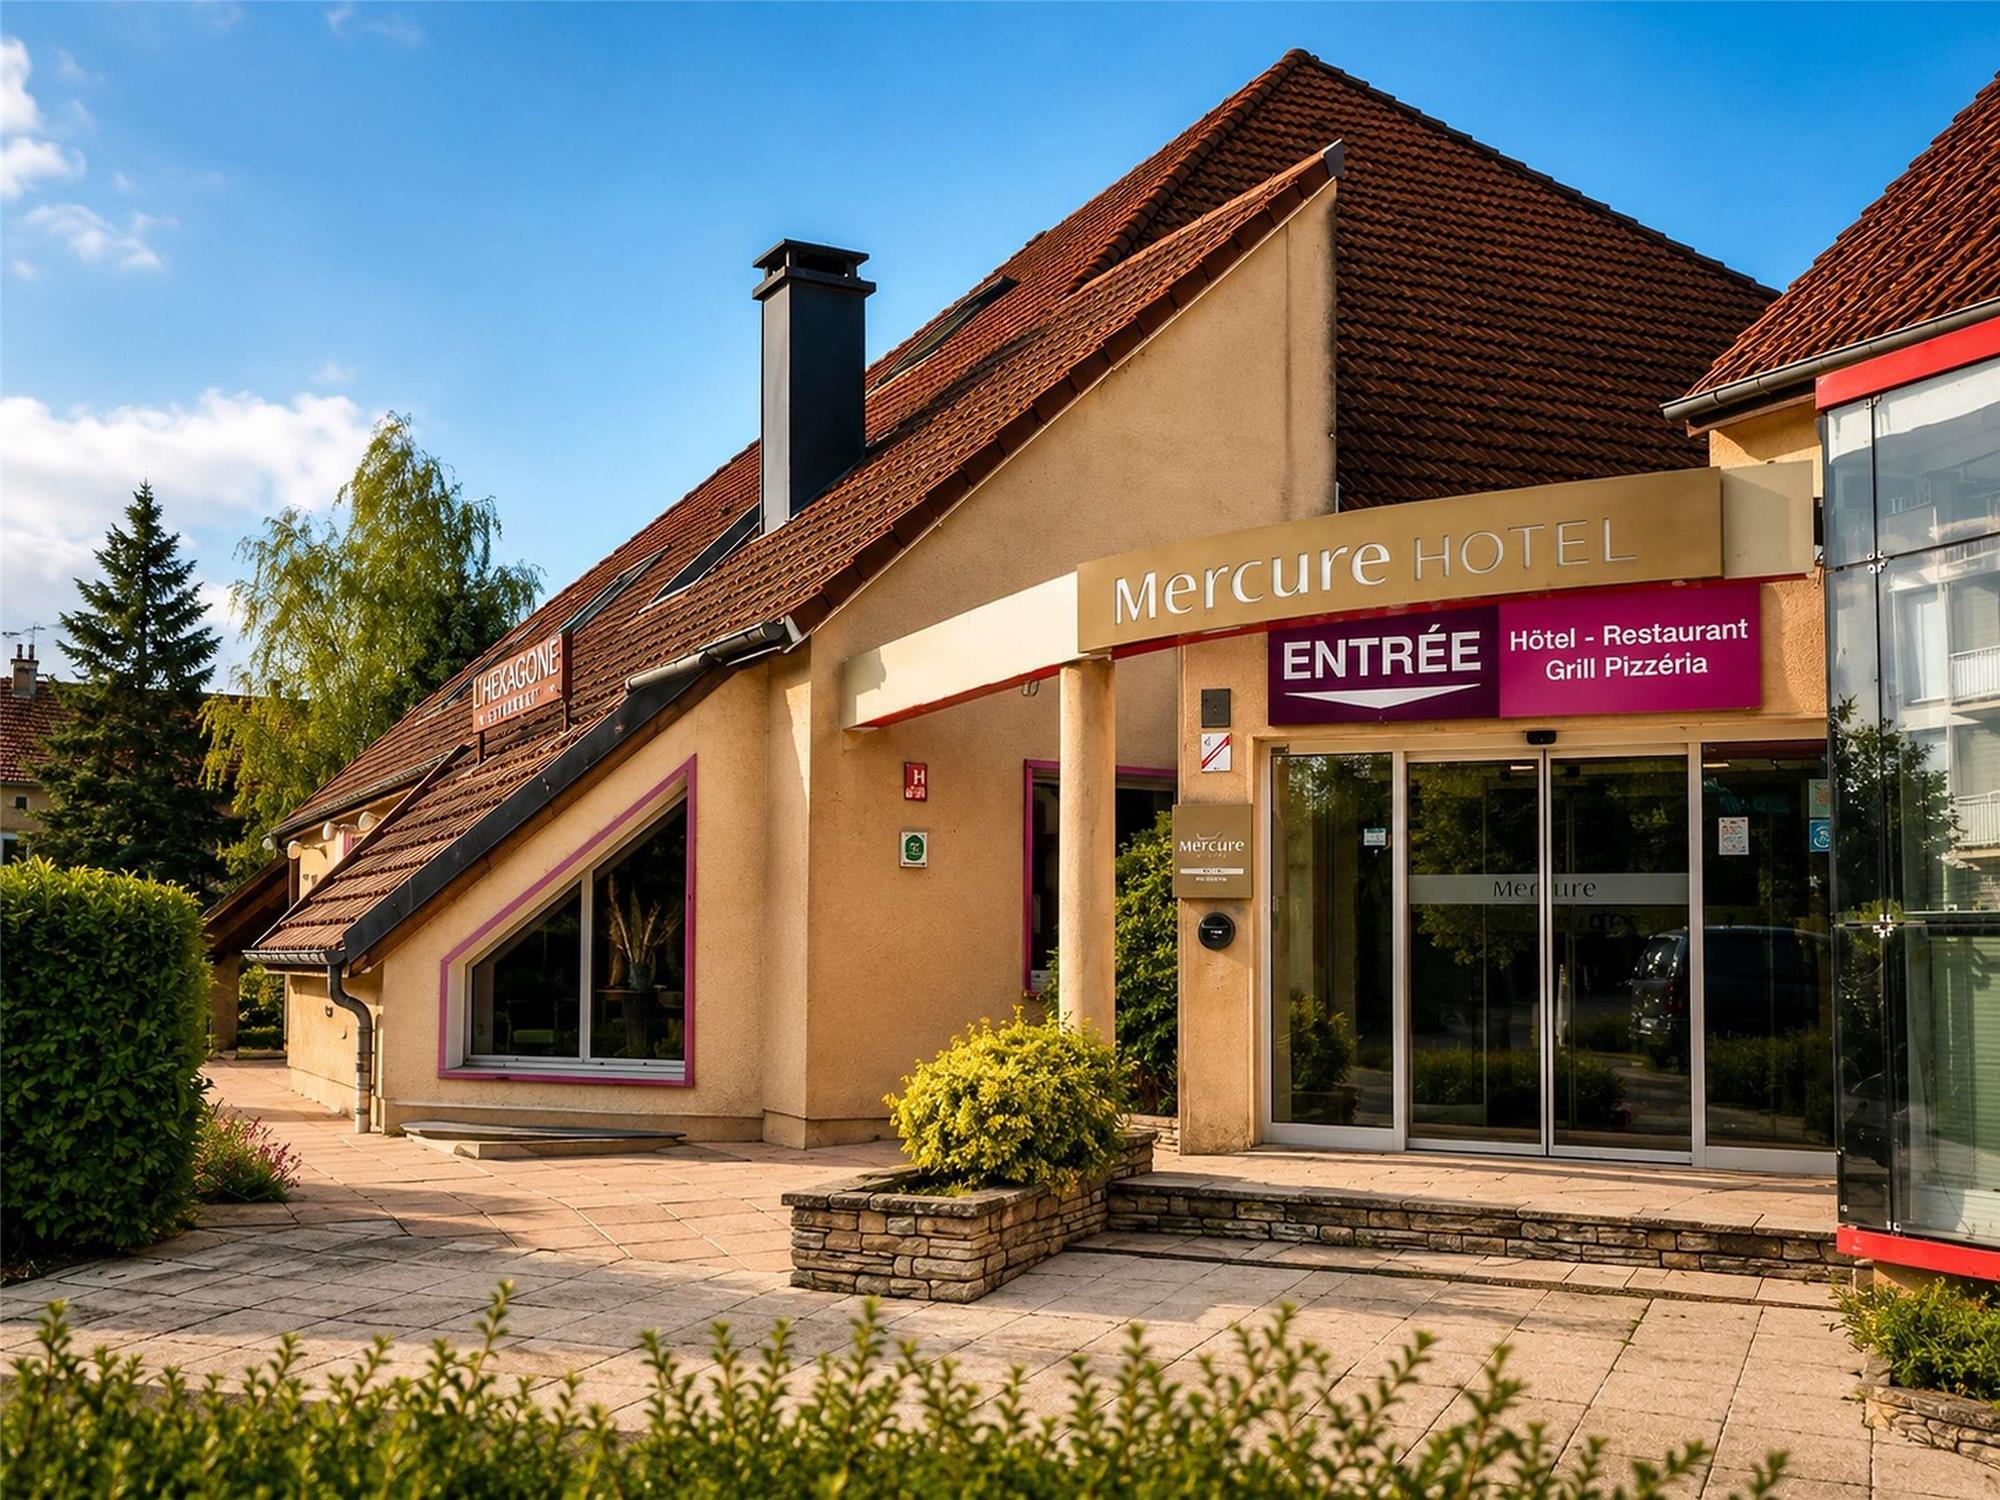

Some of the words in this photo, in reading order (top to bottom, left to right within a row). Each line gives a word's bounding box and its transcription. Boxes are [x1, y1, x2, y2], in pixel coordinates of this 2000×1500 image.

[1114, 541, 1391, 625] Mercure
[1414, 516, 1637, 581] HOTEL
[1603, 618, 1748, 646] Restaurant
[1283, 623, 1482, 680] ENTRÉE
[1545, 657, 1596, 681] Grill
[1605, 651, 1708, 677] Pizzéria
[913, 769, 925, 785] H
[1179, 840, 1245, 852] Mercure
